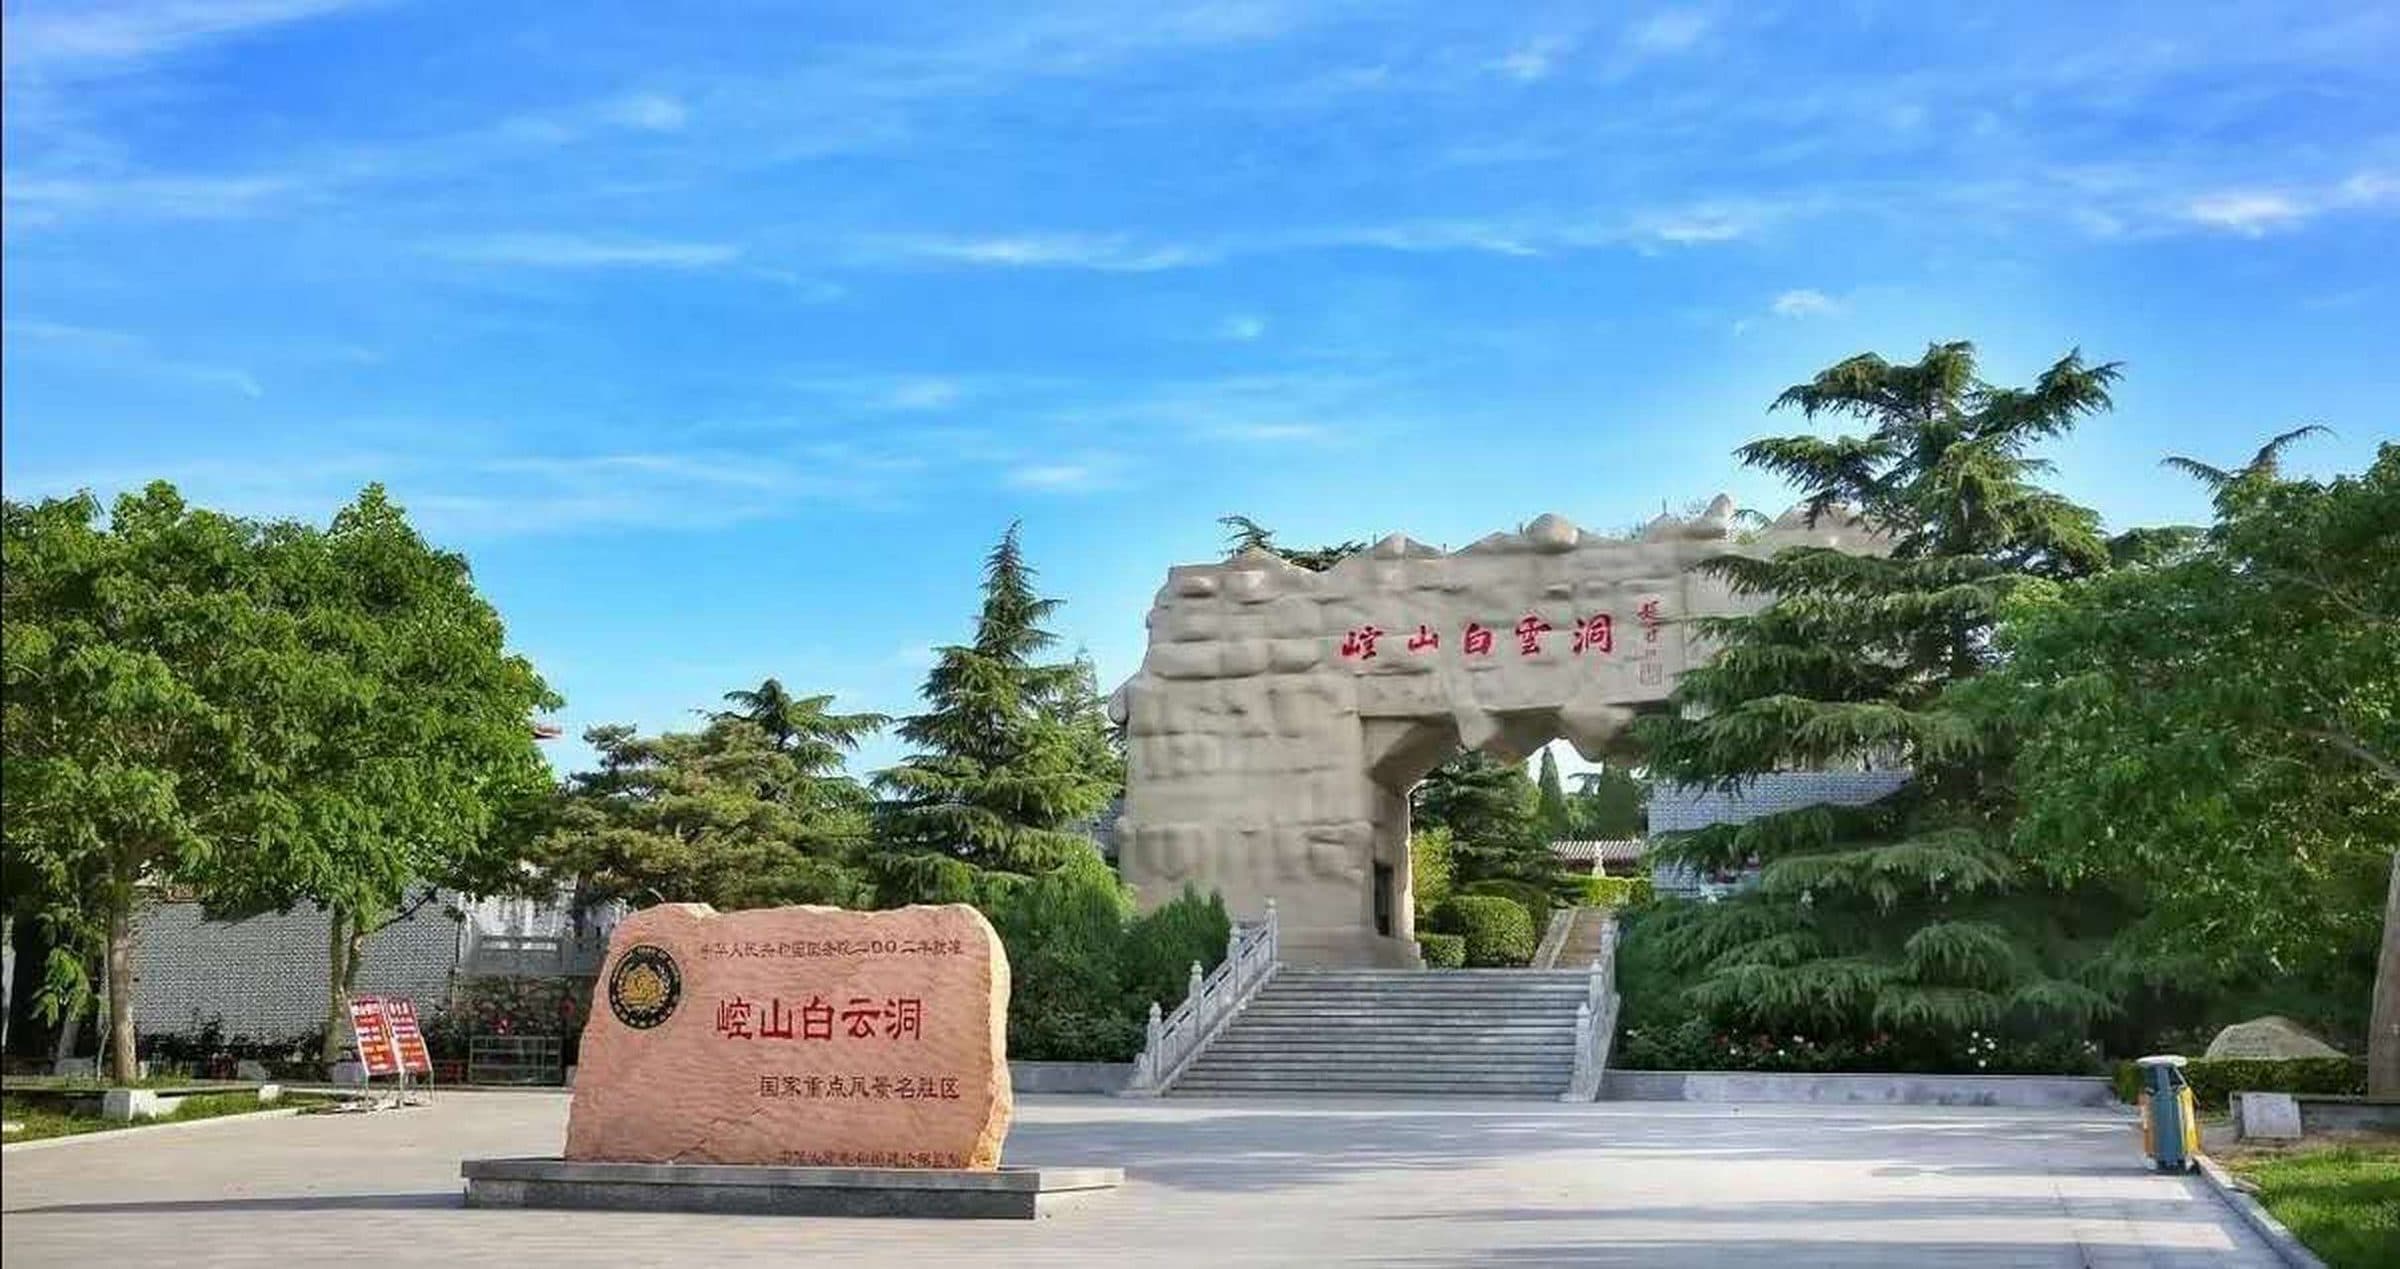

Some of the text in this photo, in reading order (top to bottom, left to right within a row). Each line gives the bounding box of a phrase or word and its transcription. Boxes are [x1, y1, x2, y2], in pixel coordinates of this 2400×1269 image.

[1341, 613, 1612, 660] 崆山白雲洞
[716, 996, 921, 1041] 崆山白云洞
[760, 1075, 961, 1099] 国家重点风景名胜区
